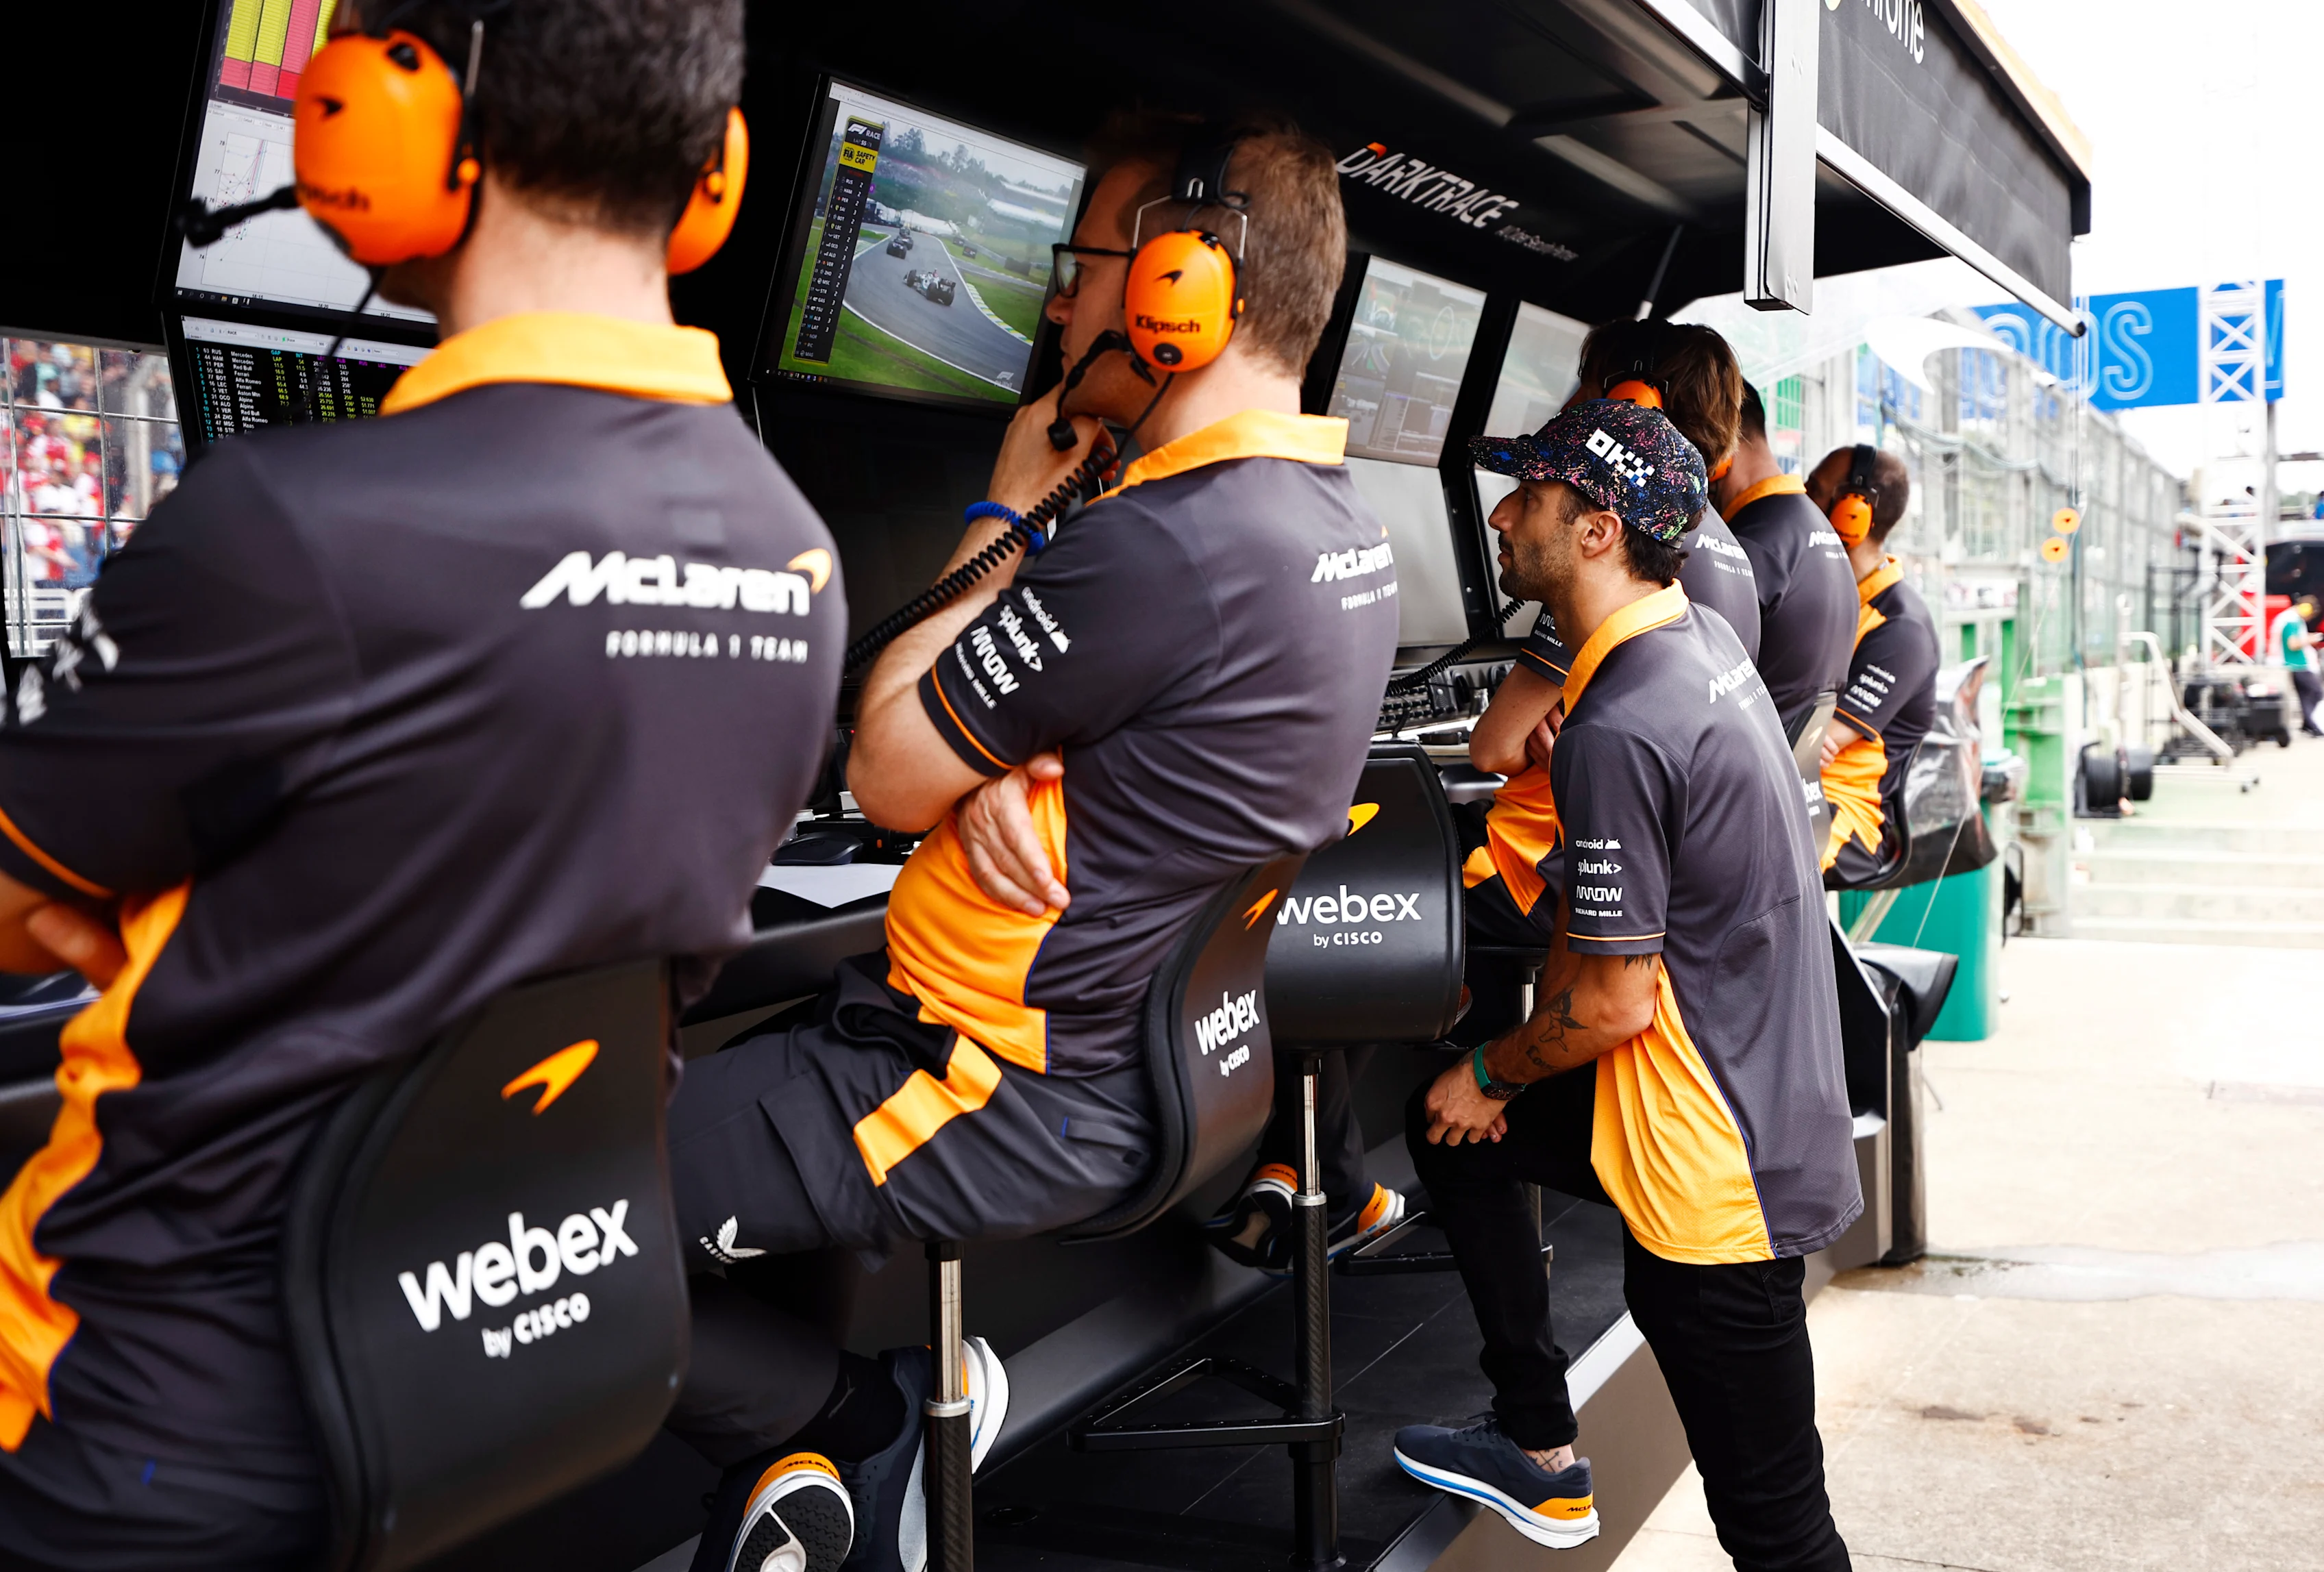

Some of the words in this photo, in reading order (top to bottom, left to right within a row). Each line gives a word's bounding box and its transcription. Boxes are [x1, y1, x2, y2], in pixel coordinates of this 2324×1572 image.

[865, 130, 881, 140] RACE
[856, 151, 876, 161] SAFETY
[1335, 142, 1519, 228] DARKTRACE
[1135, 314, 1201, 334] Klipsch
[1310, 542, 1394, 583] McLaren
[519, 551, 811, 616] McLaren
[1022, 586, 1059, 634] android
[1341, 590, 1376, 611] FORMULA
[606, 629, 719, 658] FORMULA
[729, 634, 741, 659] 1
[751, 636, 808, 664] TEAM
[1546, 635, 1563, 648] MILLE
[972, 678, 998, 710] MILLE
[1709, 657, 1756, 704] McLare
[1576, 838, 1603, 849] android
[1276, 884, 1422, 925] webex
[1575, 908, 1597, 916] RICHARD
[1313, 934, 1329, 949] by
[1333, 931, 1383, 945] CISCO
[1194, 989, 1260, 1056] webex
[1219, 1059, 1229, 1077] by
[1228, 1045, 1250, 1071] CISCO
[397, 1198, 639, 1332] webex
[481, 1326, 512, 1359] by
[512, 1292, 591, 1345] CISCO
